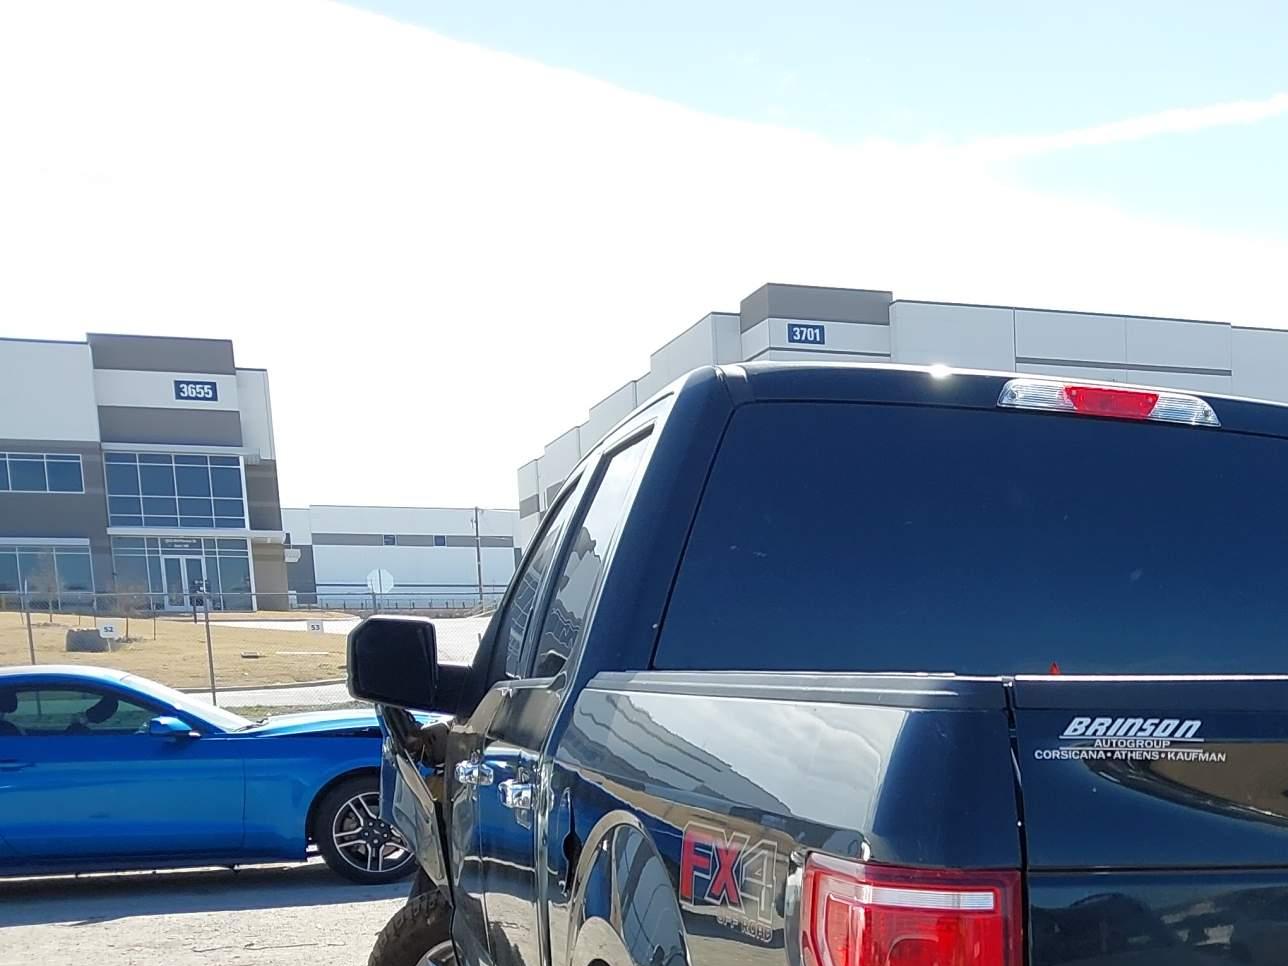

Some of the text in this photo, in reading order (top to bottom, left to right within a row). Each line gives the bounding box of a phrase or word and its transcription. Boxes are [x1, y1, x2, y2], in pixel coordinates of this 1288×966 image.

[792, 327, 820, 342] 3701
[179, 383, 213, 398] 3655
[1062, 716, 1202, 738] BRINSON
[1094, 738, 1171, 749] AUTOGROUP
[1034, 749, 1227, 762] CORSICANA ATHENS KAUFMAN
[679, 821, 778, 924] FX4
